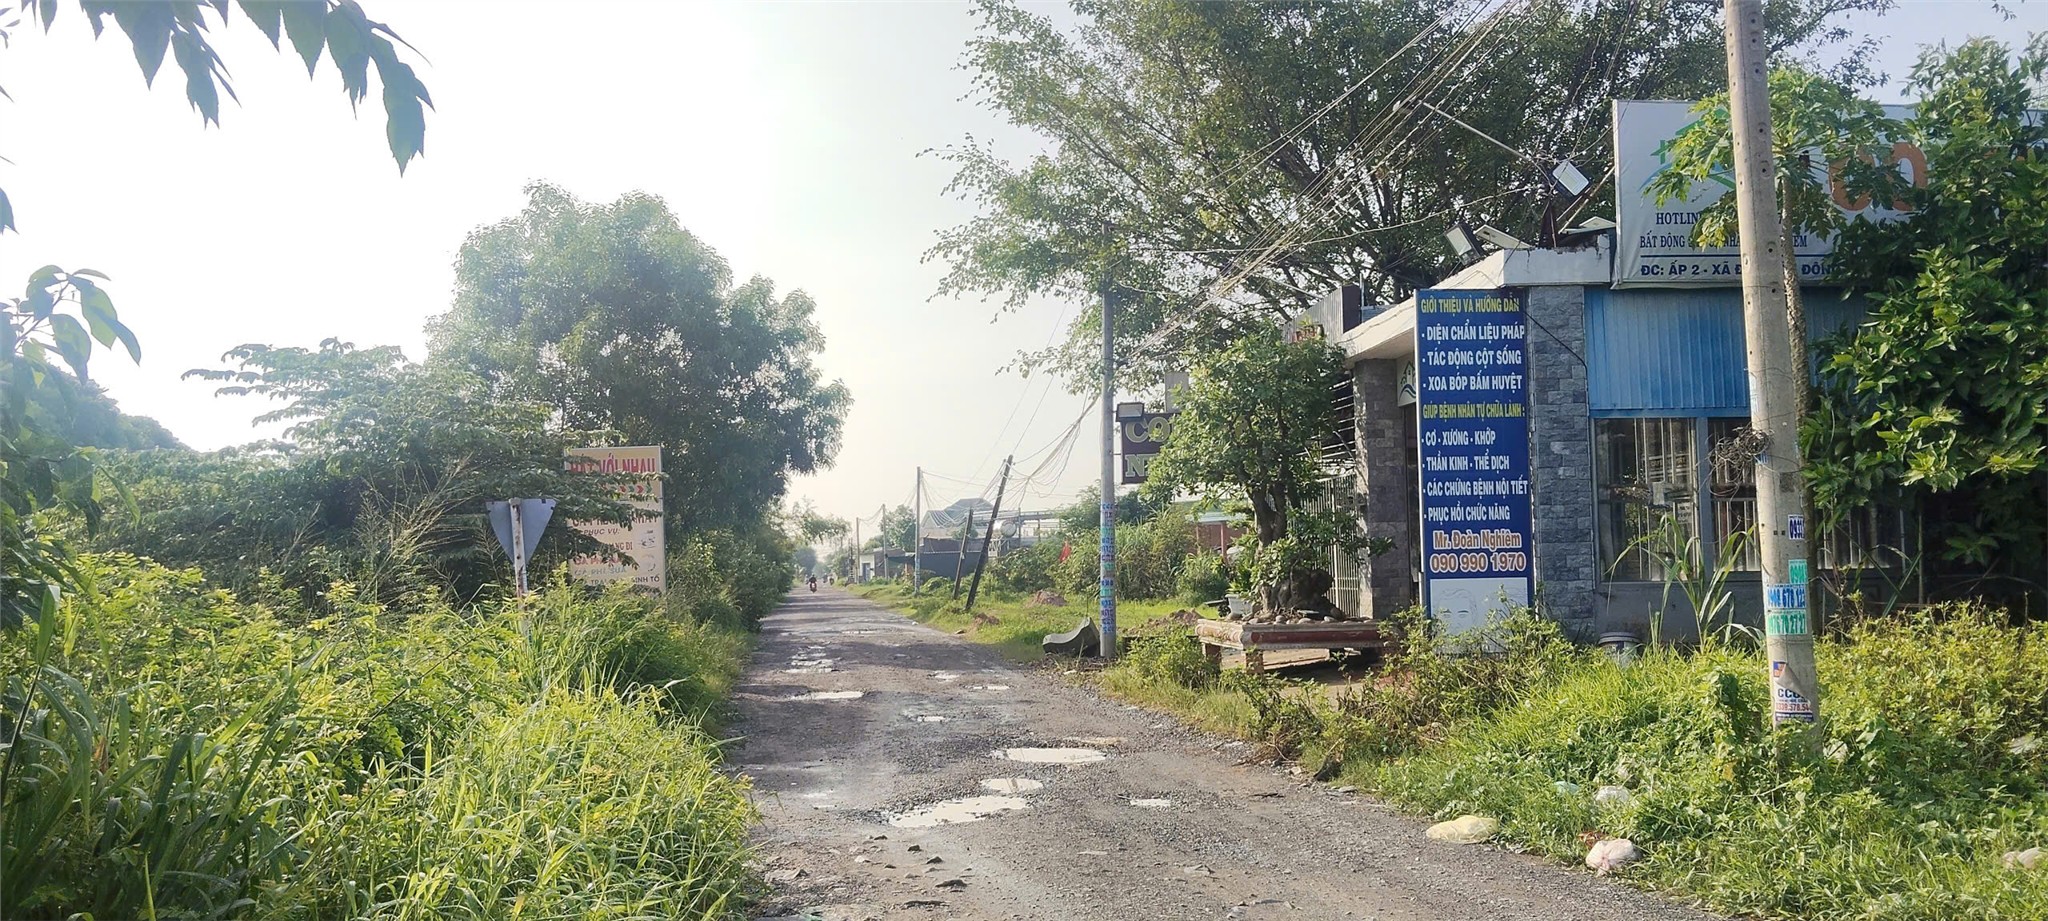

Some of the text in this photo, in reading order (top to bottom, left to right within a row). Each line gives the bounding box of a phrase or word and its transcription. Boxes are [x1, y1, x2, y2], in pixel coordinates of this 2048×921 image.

[1656, 212, 1700, 224] HOTLIN
[1661, 232, 1685, 251] ĐỘNG
[1641, 265, 1664, 276] ĐC:
[1669, 260, 1687, 275] ẤP
[1692, 264, 1700, 275] 2
[1712, 261, 1730, 275] XÃ
[1421, 295, 1436, 313] GIỚI
[1439, 296, 1461, 316] THIỆU
[1464, 295, 1474, 312] VÀ
[1476, 294, 1502, 312] HƯỚNG
[1427, 323, 1448, 344] DIỆN
[1451, 319, 1477, 340] CHẨN
[1479, 323, 1498, 343] LIỆU
[1502, 321, 1525, 339] PHÁP
[1428, 348, 1446, 365] TÁC
[1448, 348, 1473, 368] ĐỘNG
[1476, 348, 1494, 368] CỘT
[1497, 345, 1522, 365] SỐNG
[1428, 377, 1447, 390] XOA
[1450, 372, 1468, 390] BÓP
[1470, 370, 1490, 390] BẤM
[1492, 373, 1522, 393] HUYỆT
[1423, 401, 1437, 419] GIÚP
[1439, 402, 1456, 422] BỆNH
[1458, 401, 1475, 418] NHÂN
[1505, 400, 1521, 417] LÀNH
[1426, 429, 1437, 446] CƠ
[1442, 431, 1469, 446] XƯƠNG
[1475, 427, 1496, 445] KHỚP
[1427, 451, 1447, 471] THẦN
[1449, 456, 1468, 471] KINH
[1474, 449, 1489, 470] THỂ
[1491, 456, 1509, 473] DỊCH
[1427, 479, 1443, 496] CÁC
[1444, 478, 1471, 496] CHỨNG
[1473, 478, 1494, 499] BỆNH
[1496, 478, 1509, 498] NỘI
[1511, 475, 1528, 494] TIẾT
[1428, 507, 1449, 525] PHỤC
[1466, 503, 1487, 521] CHỨC
[1489, 505, 1510, 520] NĂNG
[1433, 529, 1522, 552] Mr. Đoàn Nghiêm
[1430, 552, 1526, 572] 090 990 1970
